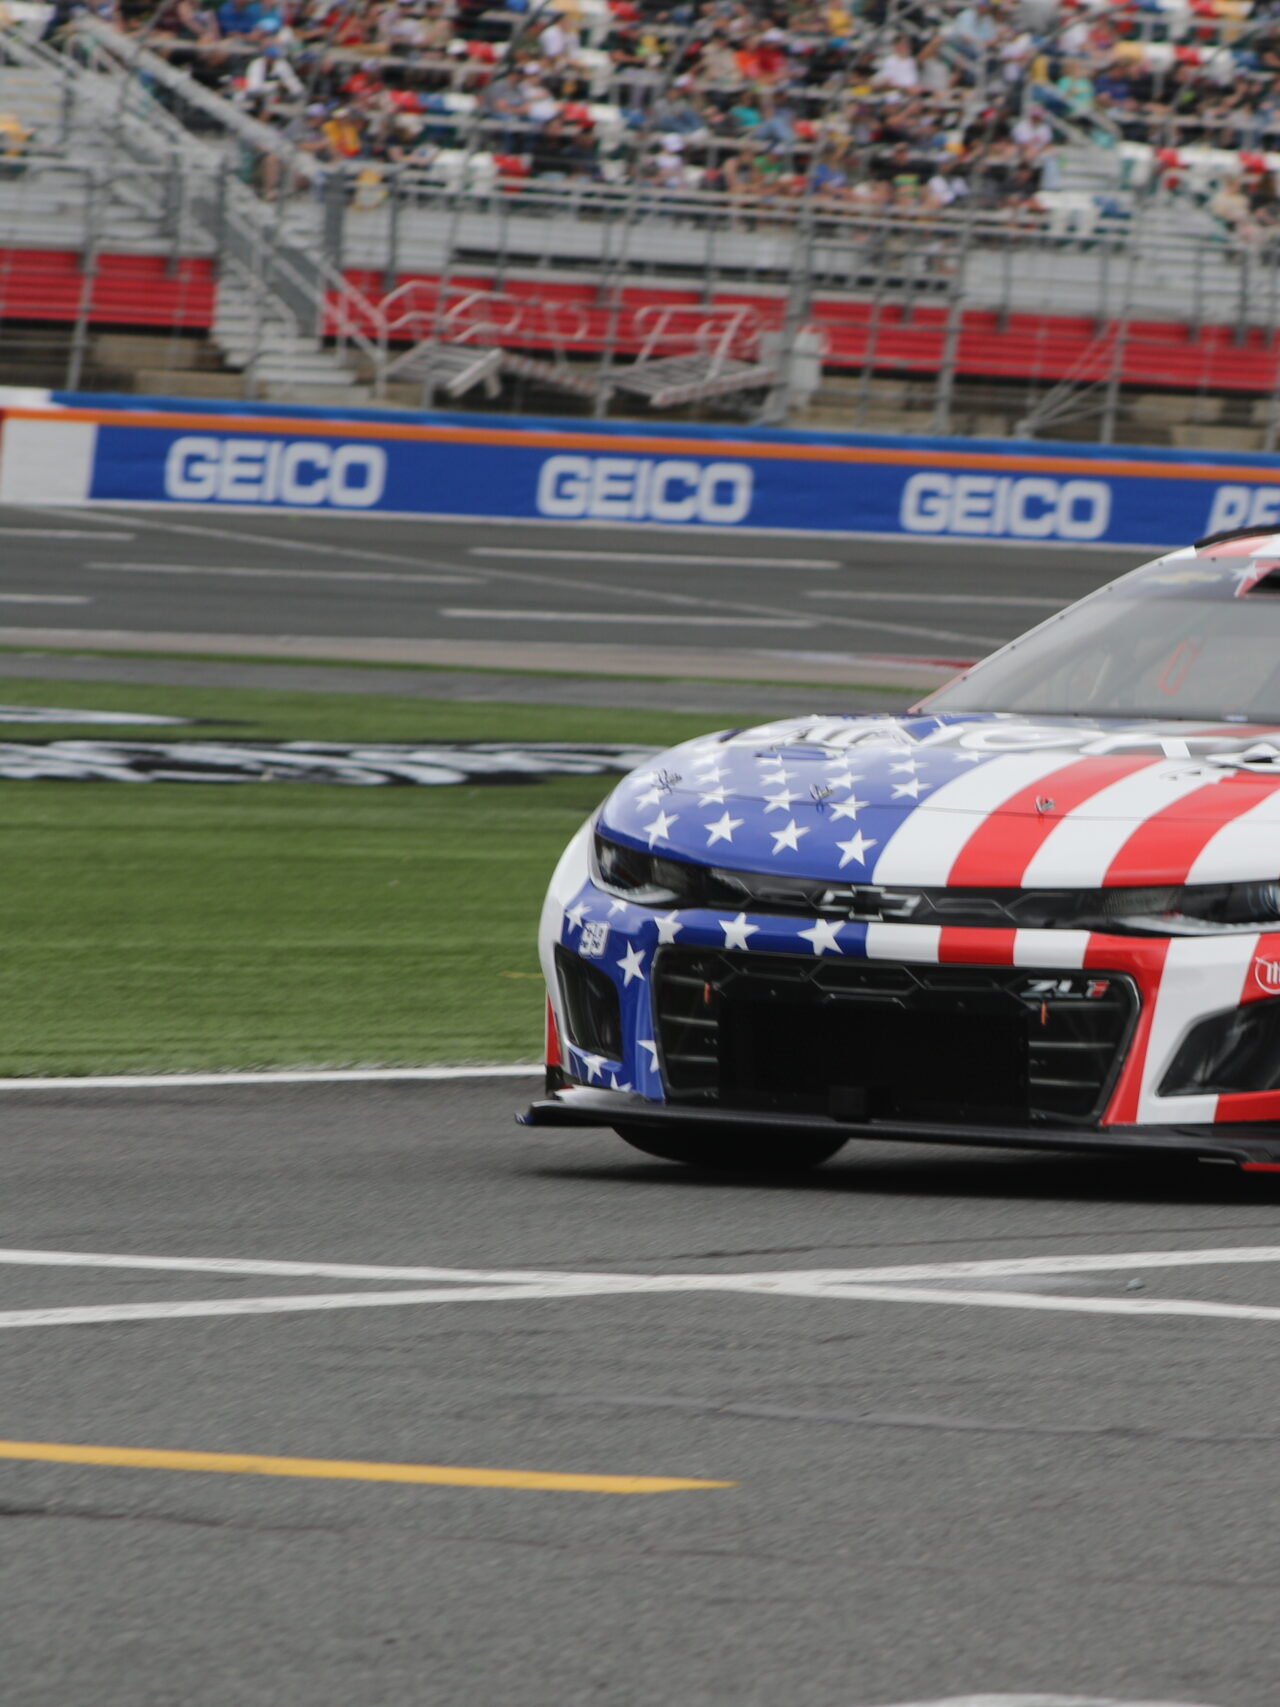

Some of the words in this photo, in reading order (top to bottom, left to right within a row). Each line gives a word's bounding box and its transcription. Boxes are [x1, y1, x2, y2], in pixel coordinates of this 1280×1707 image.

[164, 436, 387, 507] GEICO
[537, 455, 754, 523] GEICO
[900, 472, 1111, 539] GEICO
